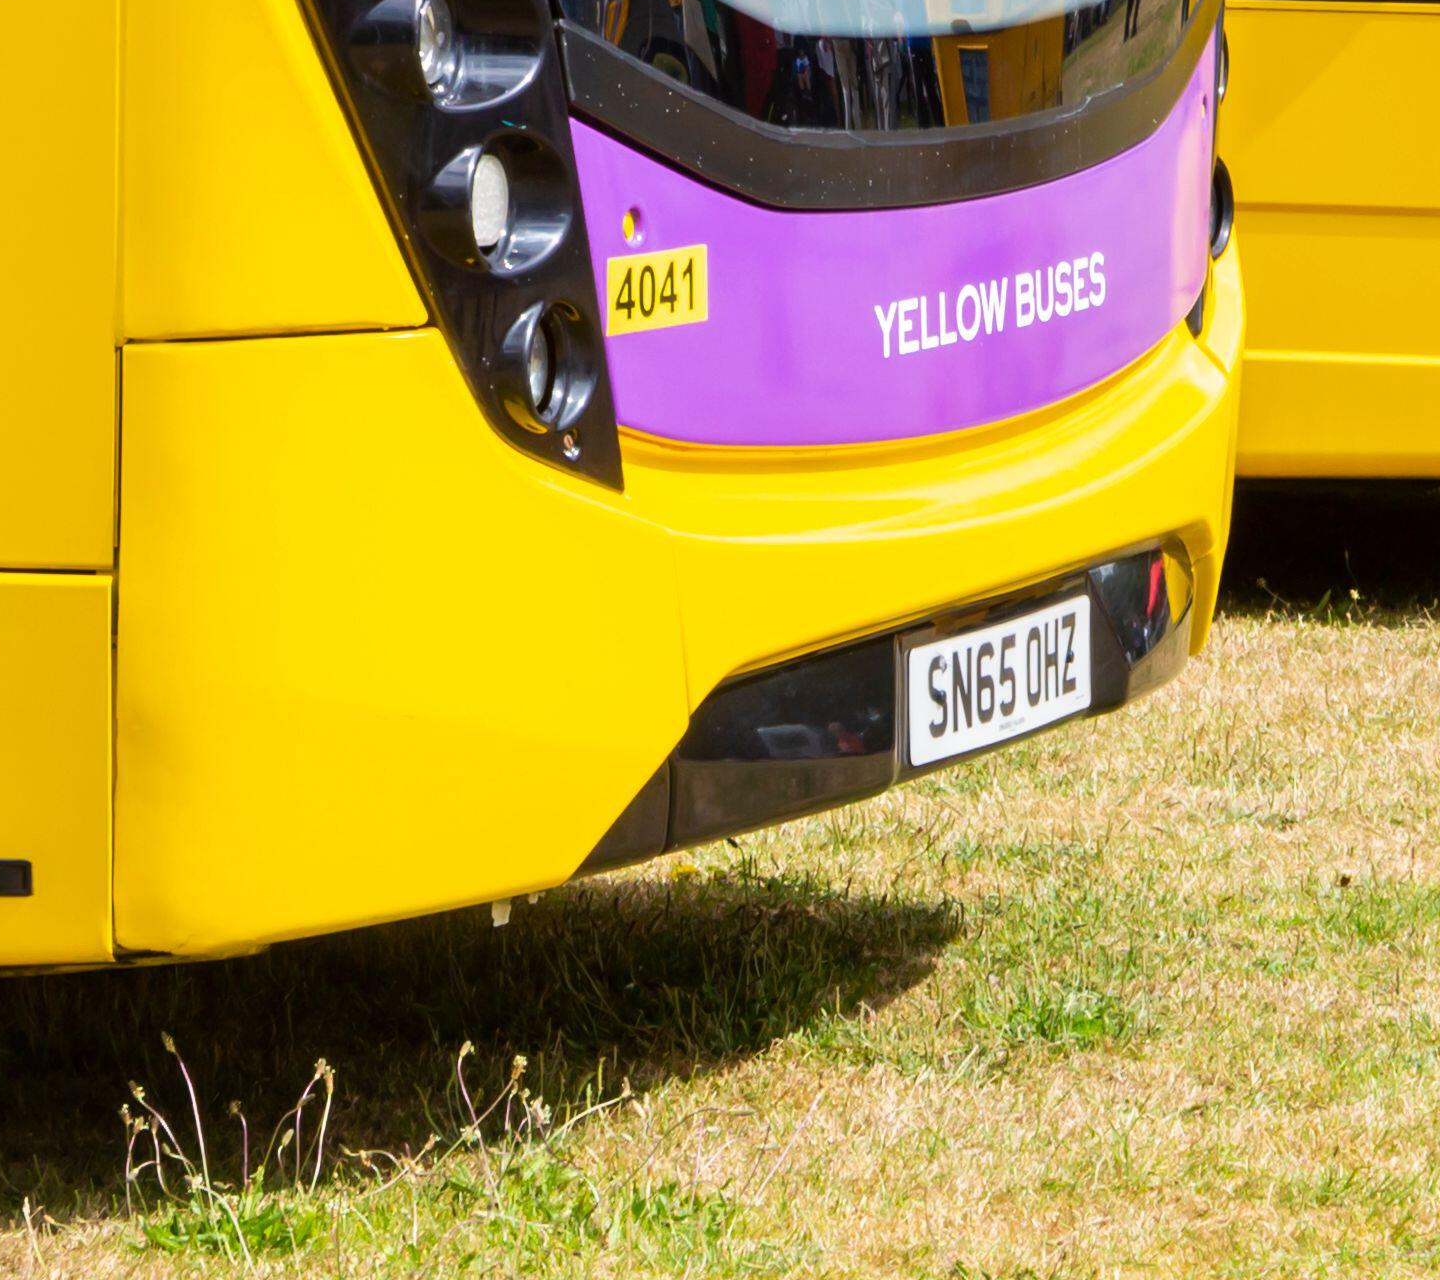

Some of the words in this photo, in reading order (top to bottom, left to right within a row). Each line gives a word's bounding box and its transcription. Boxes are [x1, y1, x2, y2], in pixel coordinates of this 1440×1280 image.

[615, 257, 696, 321] 4041
[874, 276, 1009, 359] YELLOW
[1015, 251, 1107, 328] BUSES
[928, 633, 1017, 738] SN65
[1026, 611, 1077, 708] OHZ
